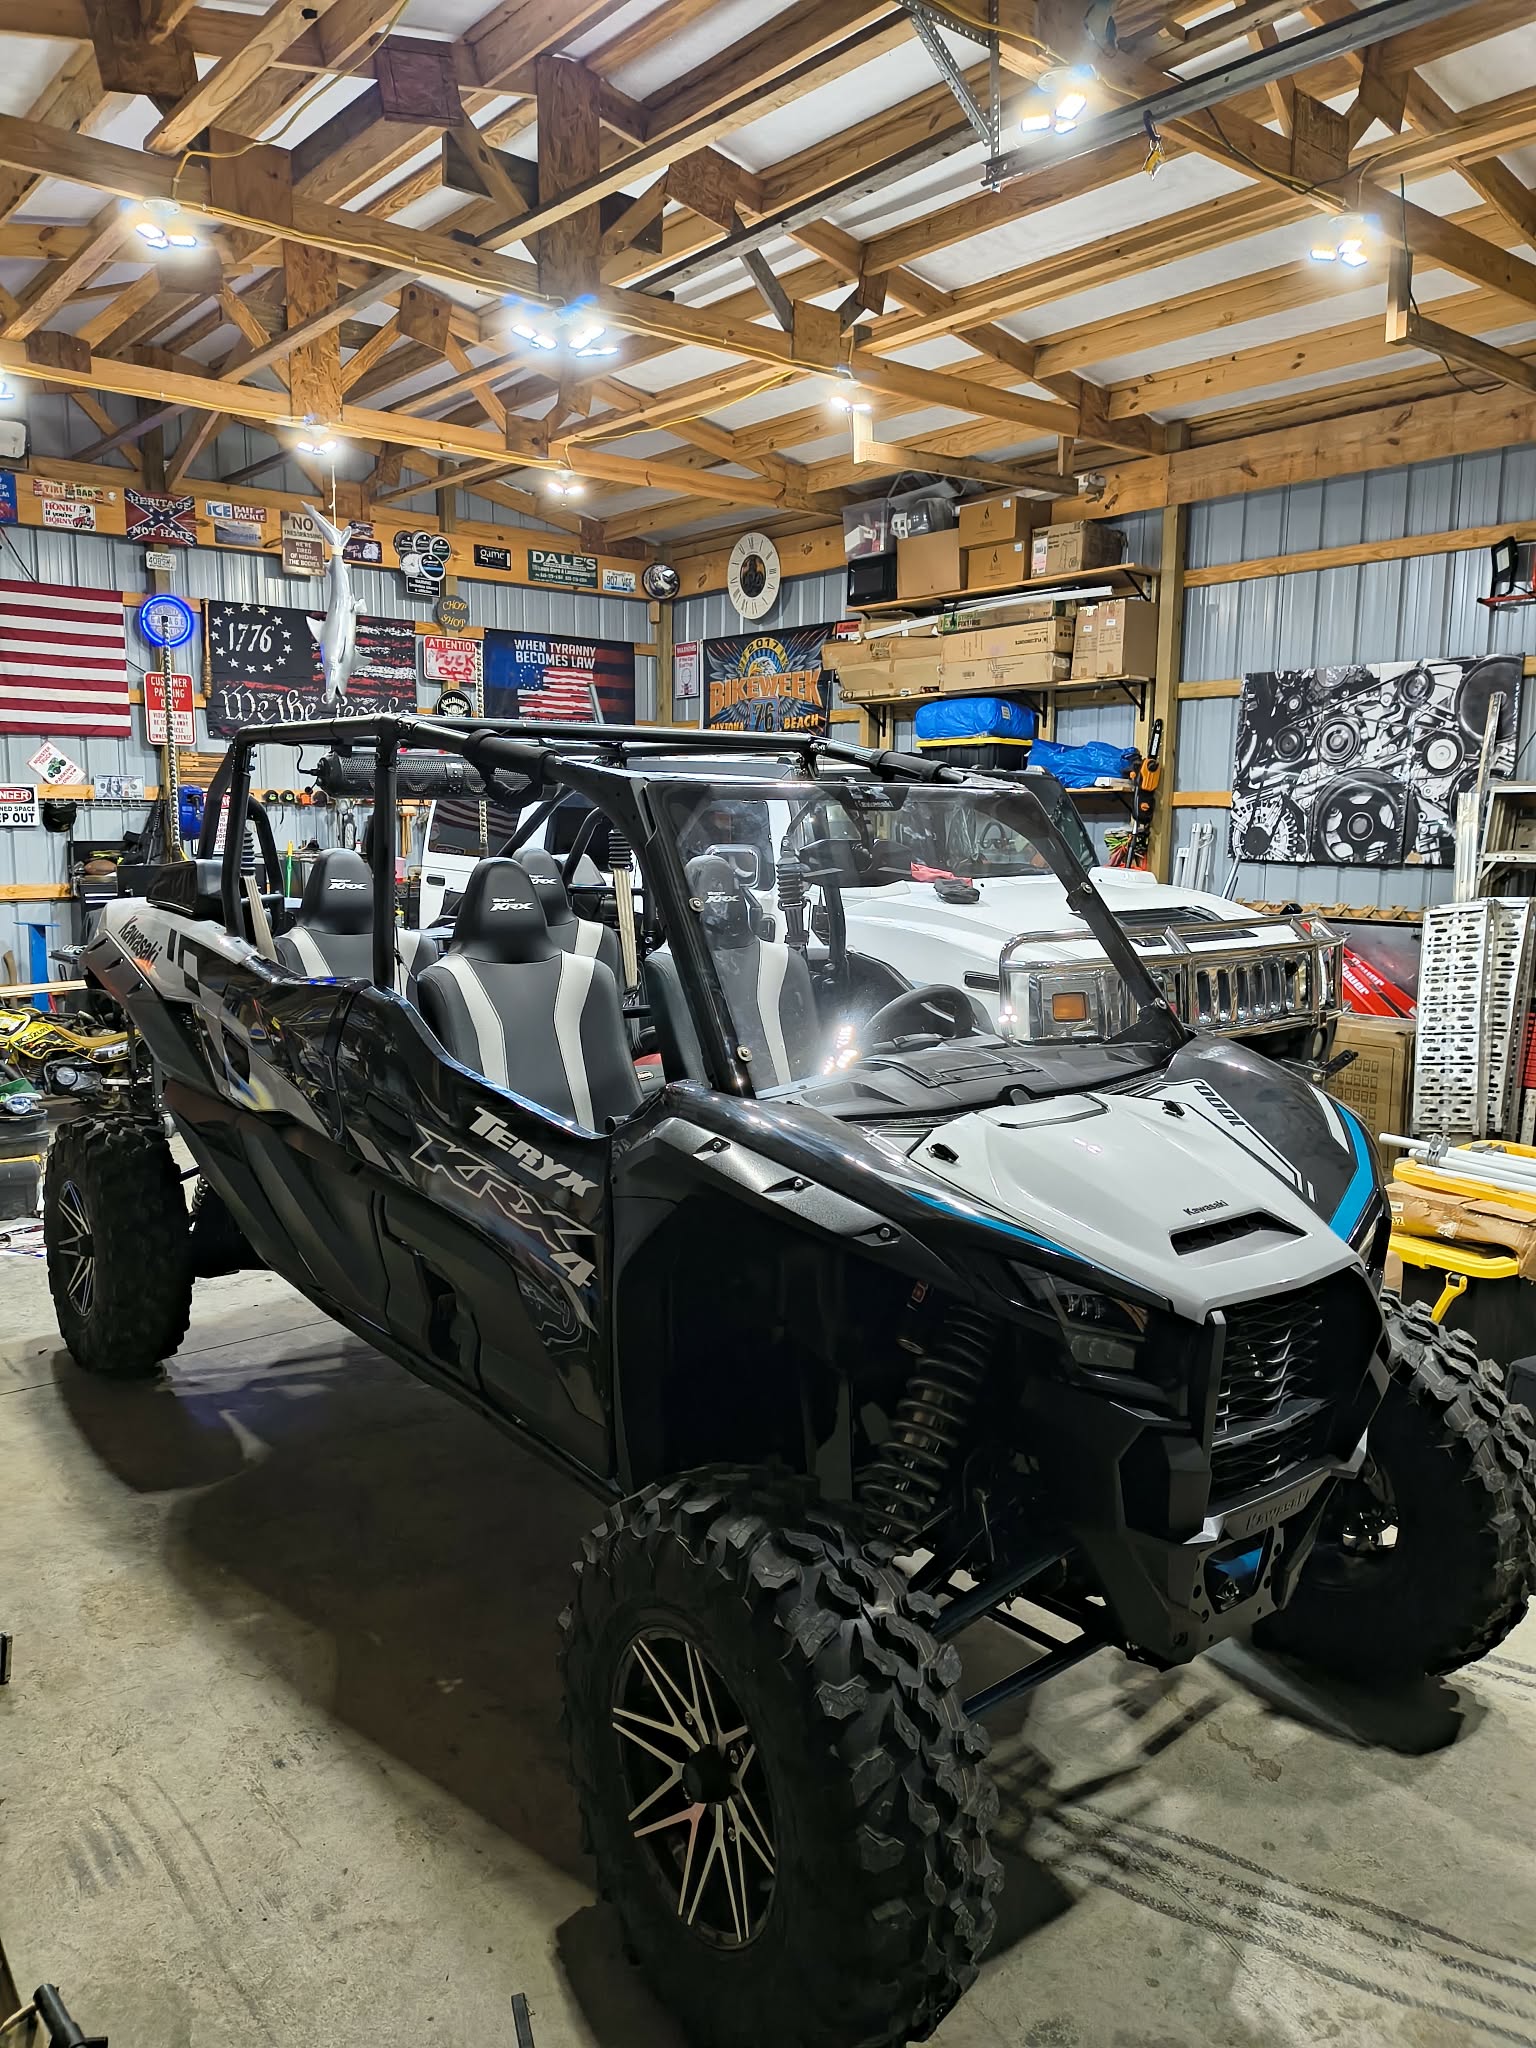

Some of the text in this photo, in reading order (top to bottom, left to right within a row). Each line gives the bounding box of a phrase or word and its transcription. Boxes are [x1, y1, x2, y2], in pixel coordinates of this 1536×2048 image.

[44, 484, 93, 498] TIKI BAR
[45, 502, 76, 512] HONK!
[130, 496, 191, 510] HERITAGE
[52, 511, 73, 519] you're
[207, 504, 231, 517] ICE
[234, 513, 265, 521] TACKLE
[45, 516, 73, 525] HORNY
[291, 516, 313, 531] NO
[132, 526, 193, 540] NOT HATE
[532, 550, 596, 571] DALE'S
[151, 615, 184, 626] GAAGE
[228, 622, 275, 653] 1776
[428, 638, 476, 652] ATTENTION
[514, 639, 596, 656] WHEN TYRANNY
[747, 638, 779, 652] 2017
[516, 651, 596, 669] BECOMES LAW
[151, 676, 187, 688] CUSMER
[154, 687, 185, 698] PAING
[219, 683, 277, 724] We
[276, 689, 321, 723] the
[754, 701, 775, 732] 76
[784, 713, 819, 730] BEACH
[55, 764, 74, 784] PARKING
[12, 812, 35, 823] OUT
[328, 882, 368, 890] KRX
[705, 895, 740, 904] KRX
[489, 902, 534, 912] KRX
[118, 915, 163, 964] Kawasaki
[1183, 1199, 1230, 1216] Kawasaki
